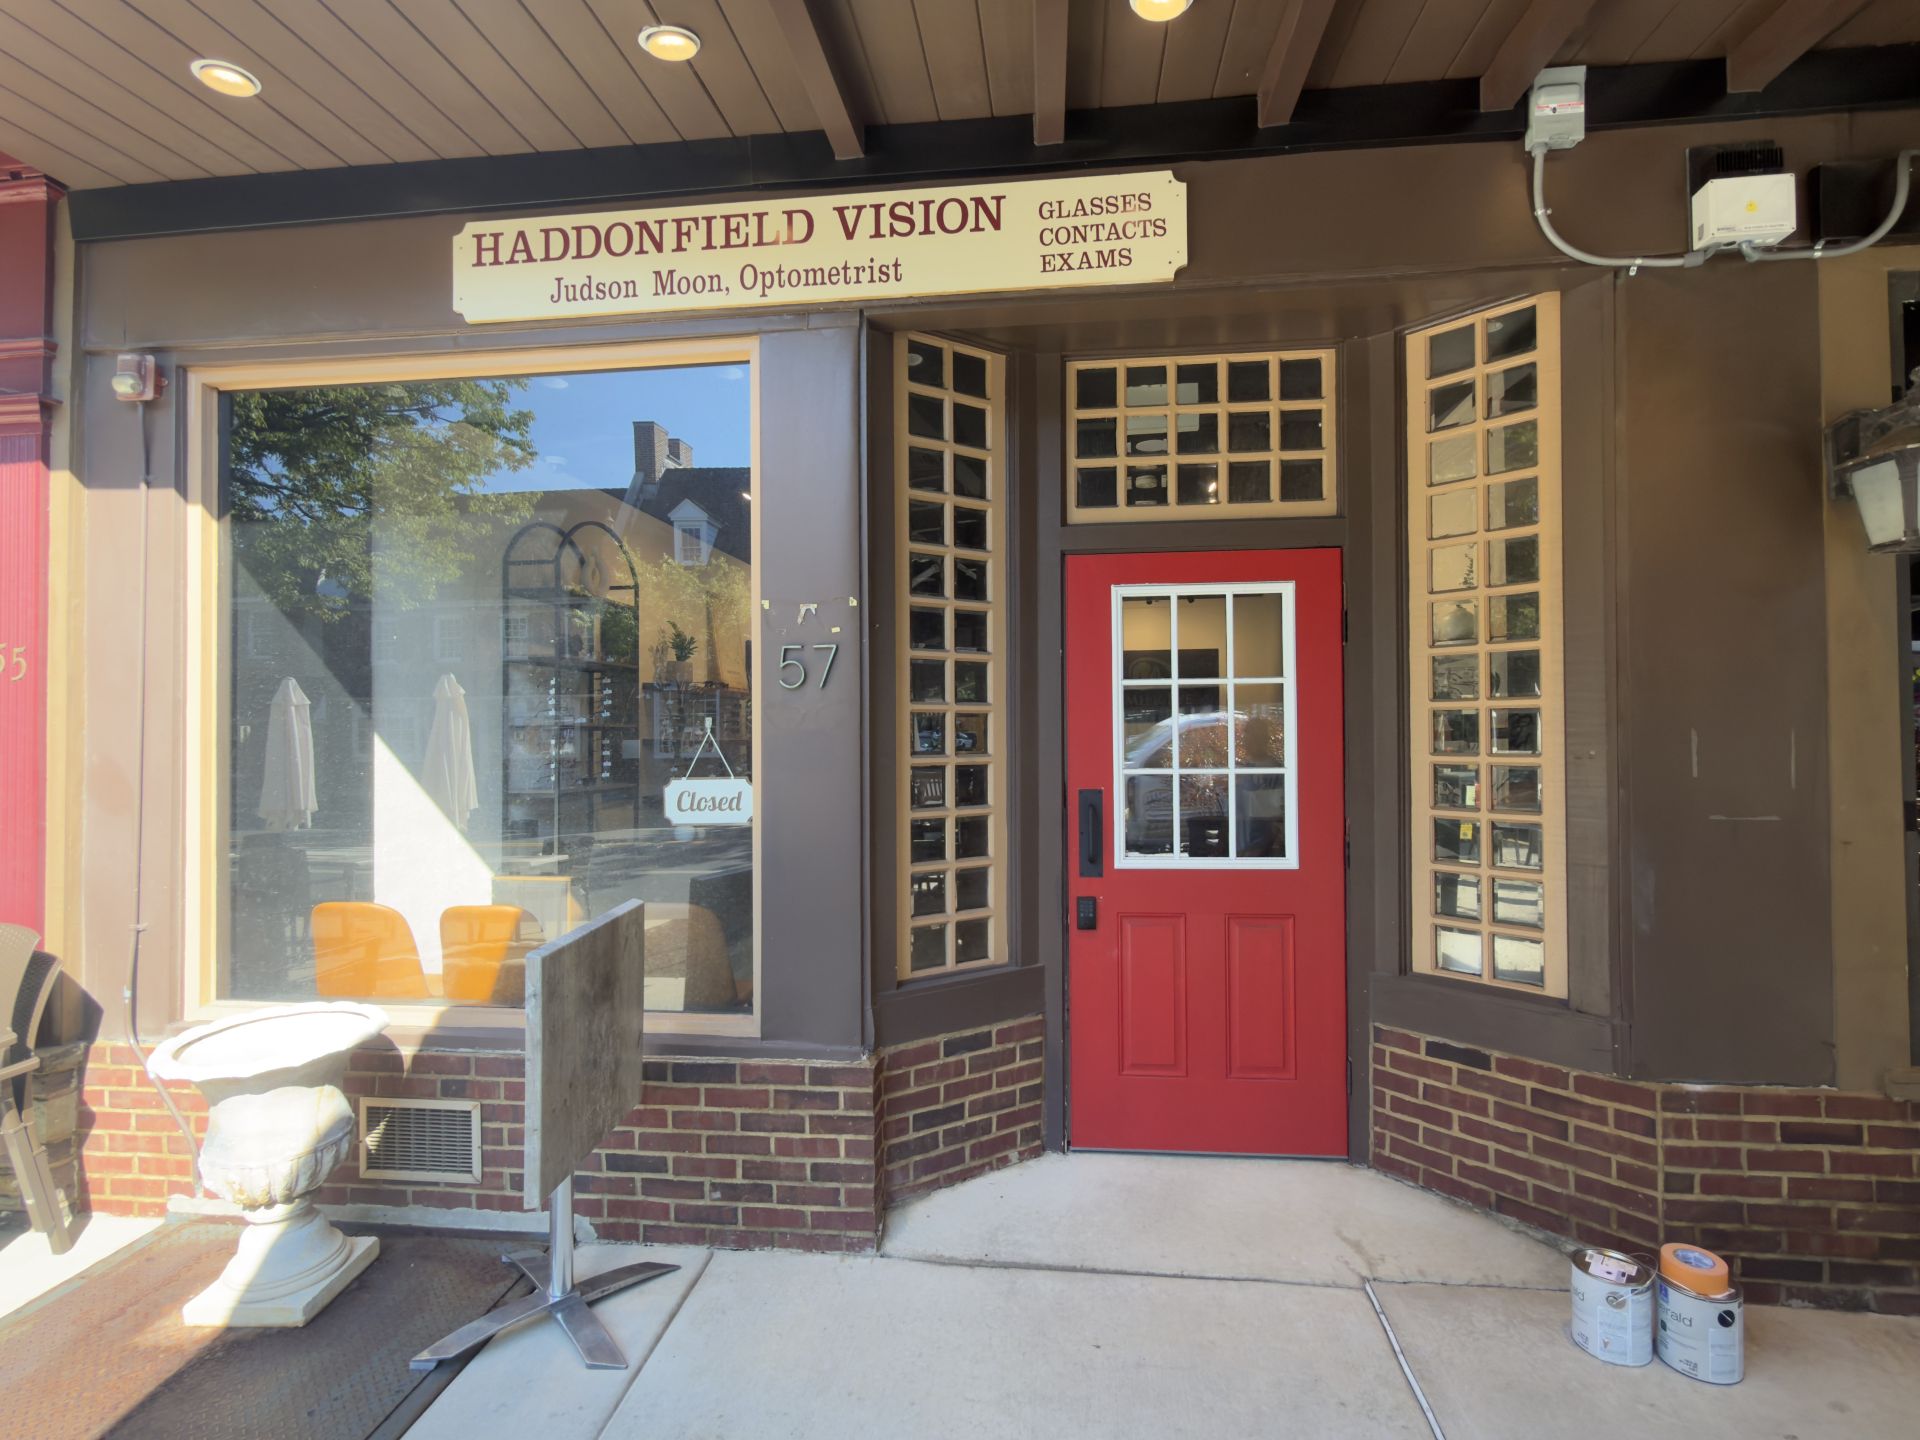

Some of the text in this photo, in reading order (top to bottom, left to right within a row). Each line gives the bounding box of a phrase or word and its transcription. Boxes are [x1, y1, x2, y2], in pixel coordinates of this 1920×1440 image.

[1039, 193, 1152, 220] GLASSES
[472, 195, 1006, 267] HADDONFIELD VISION
[1039, 218, 1167, 246] CONTACTS
[1040, 248, 1133, 273] EXAMS
[550, 257, 904, 303] Judson Moon, Optometrist
[779, 645, 839, 689] 57
[676, 789, 743, 812] Closed
